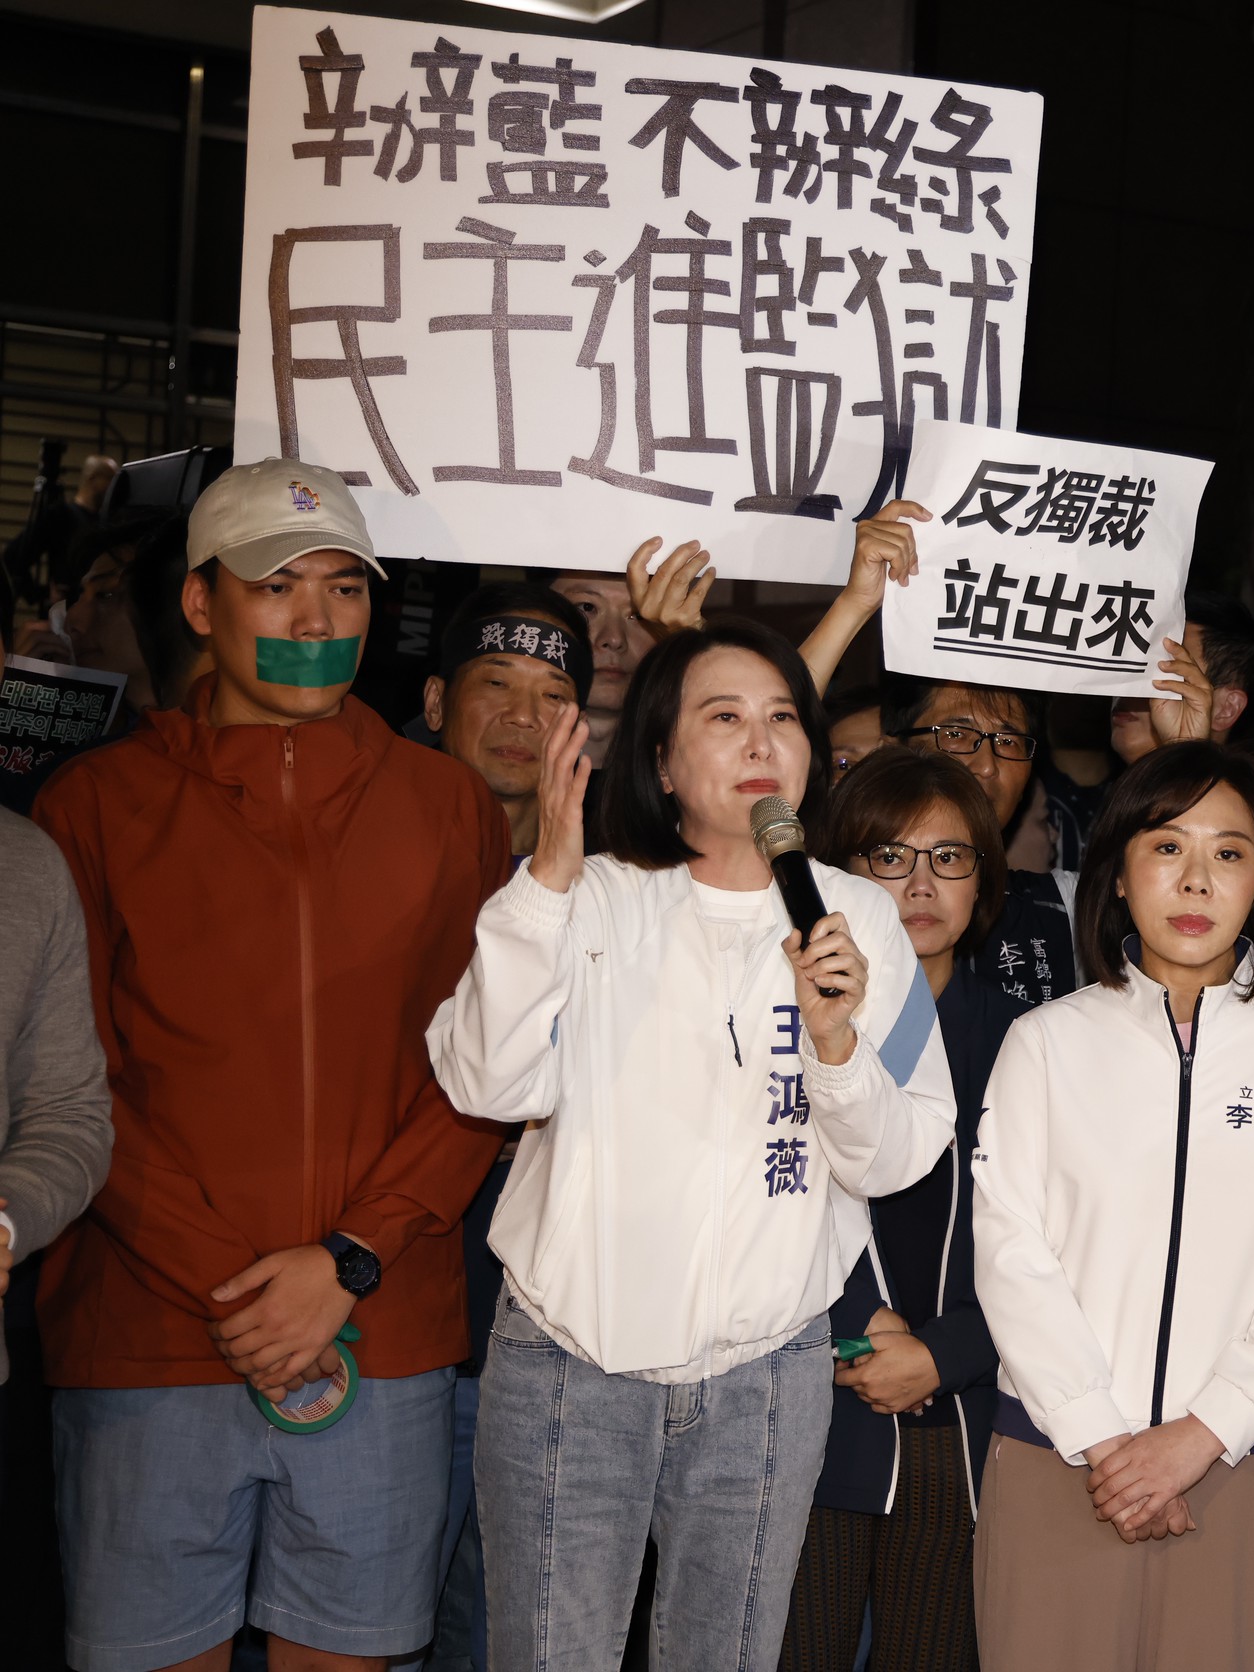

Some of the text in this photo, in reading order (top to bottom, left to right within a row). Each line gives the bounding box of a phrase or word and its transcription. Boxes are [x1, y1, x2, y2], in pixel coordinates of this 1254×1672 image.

[267, 210, 1019, 522] 民主進監獄
[941, 459, 1157, 551] 反獨裁
[476, 622, 569, 671] 戰獨裁
[937, 558, 1155, 657] 站出來
[0, 680, 61, 713] 대만판
[764, 1004, 811, 1198] 王鴻薇
